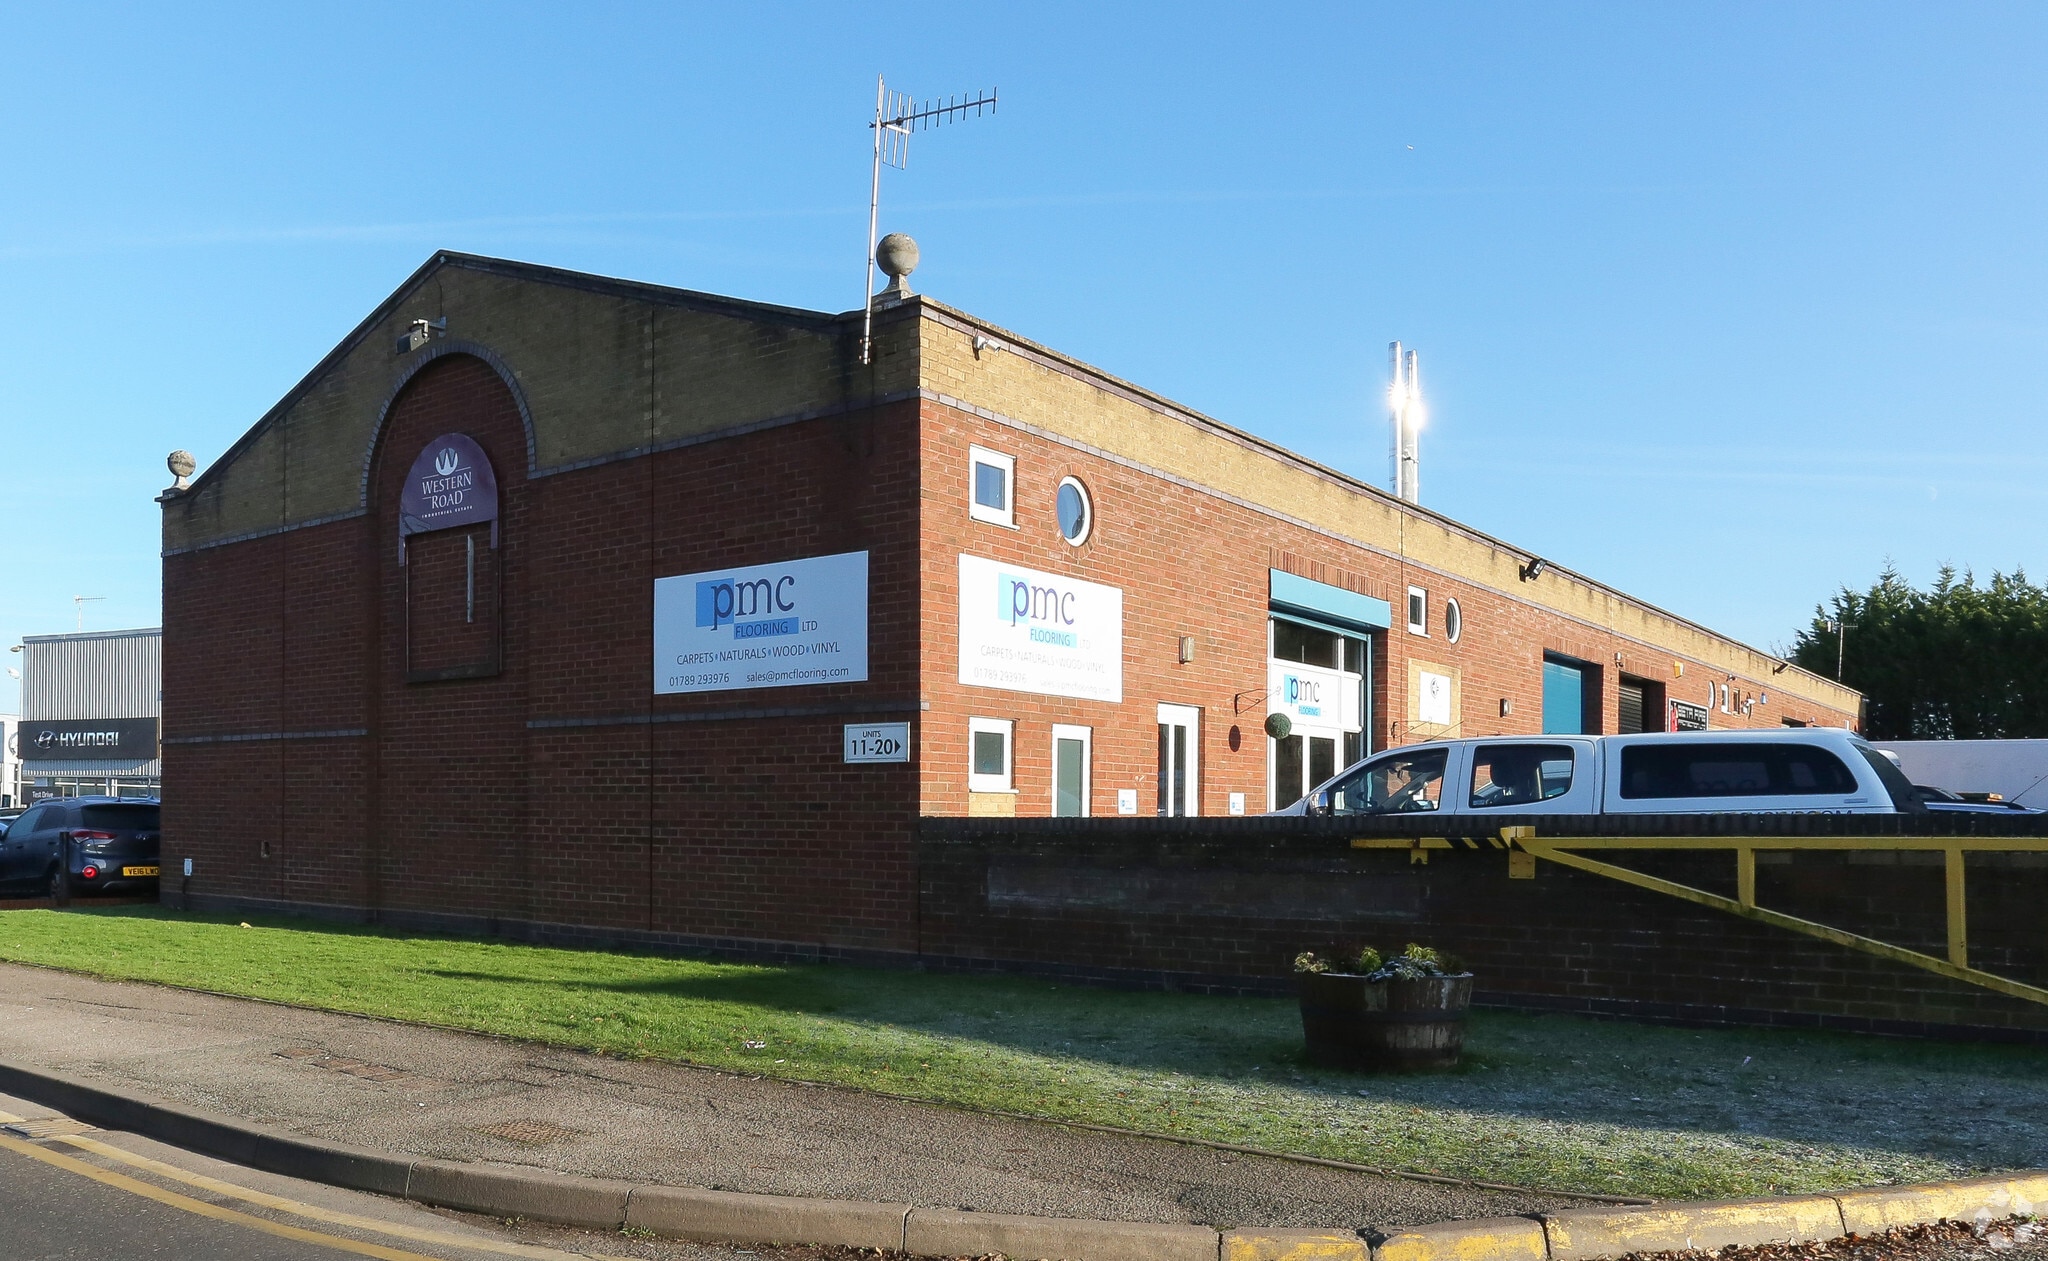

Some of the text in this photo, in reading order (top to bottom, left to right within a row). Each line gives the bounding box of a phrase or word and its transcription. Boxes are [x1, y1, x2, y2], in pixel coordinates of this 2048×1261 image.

[422, 471, 472, 495] WESTERN
[431, 490, 463, 509] ROAD
[711, 575, 795, 631] pmc
[1011, 580, 1075, 627] pmc
[735, 620, 818, 638] FLOORING LTD
[1030, 628, 1071, 647] FLOORING
[669, 672, 730, 687] 01789 293976
[746, 666, 849, 683] sales@pmcflooring.com
[973, 667, 998, 680] 01789
[1289, 677, 1320, 706] pmc
[60, 731, 119, 746] HYUNDAI
[862, 730, 882, 738] UNITS
[851, 738, 893, 755] 11-20
[32, 791, 54, 799] Test Drive
